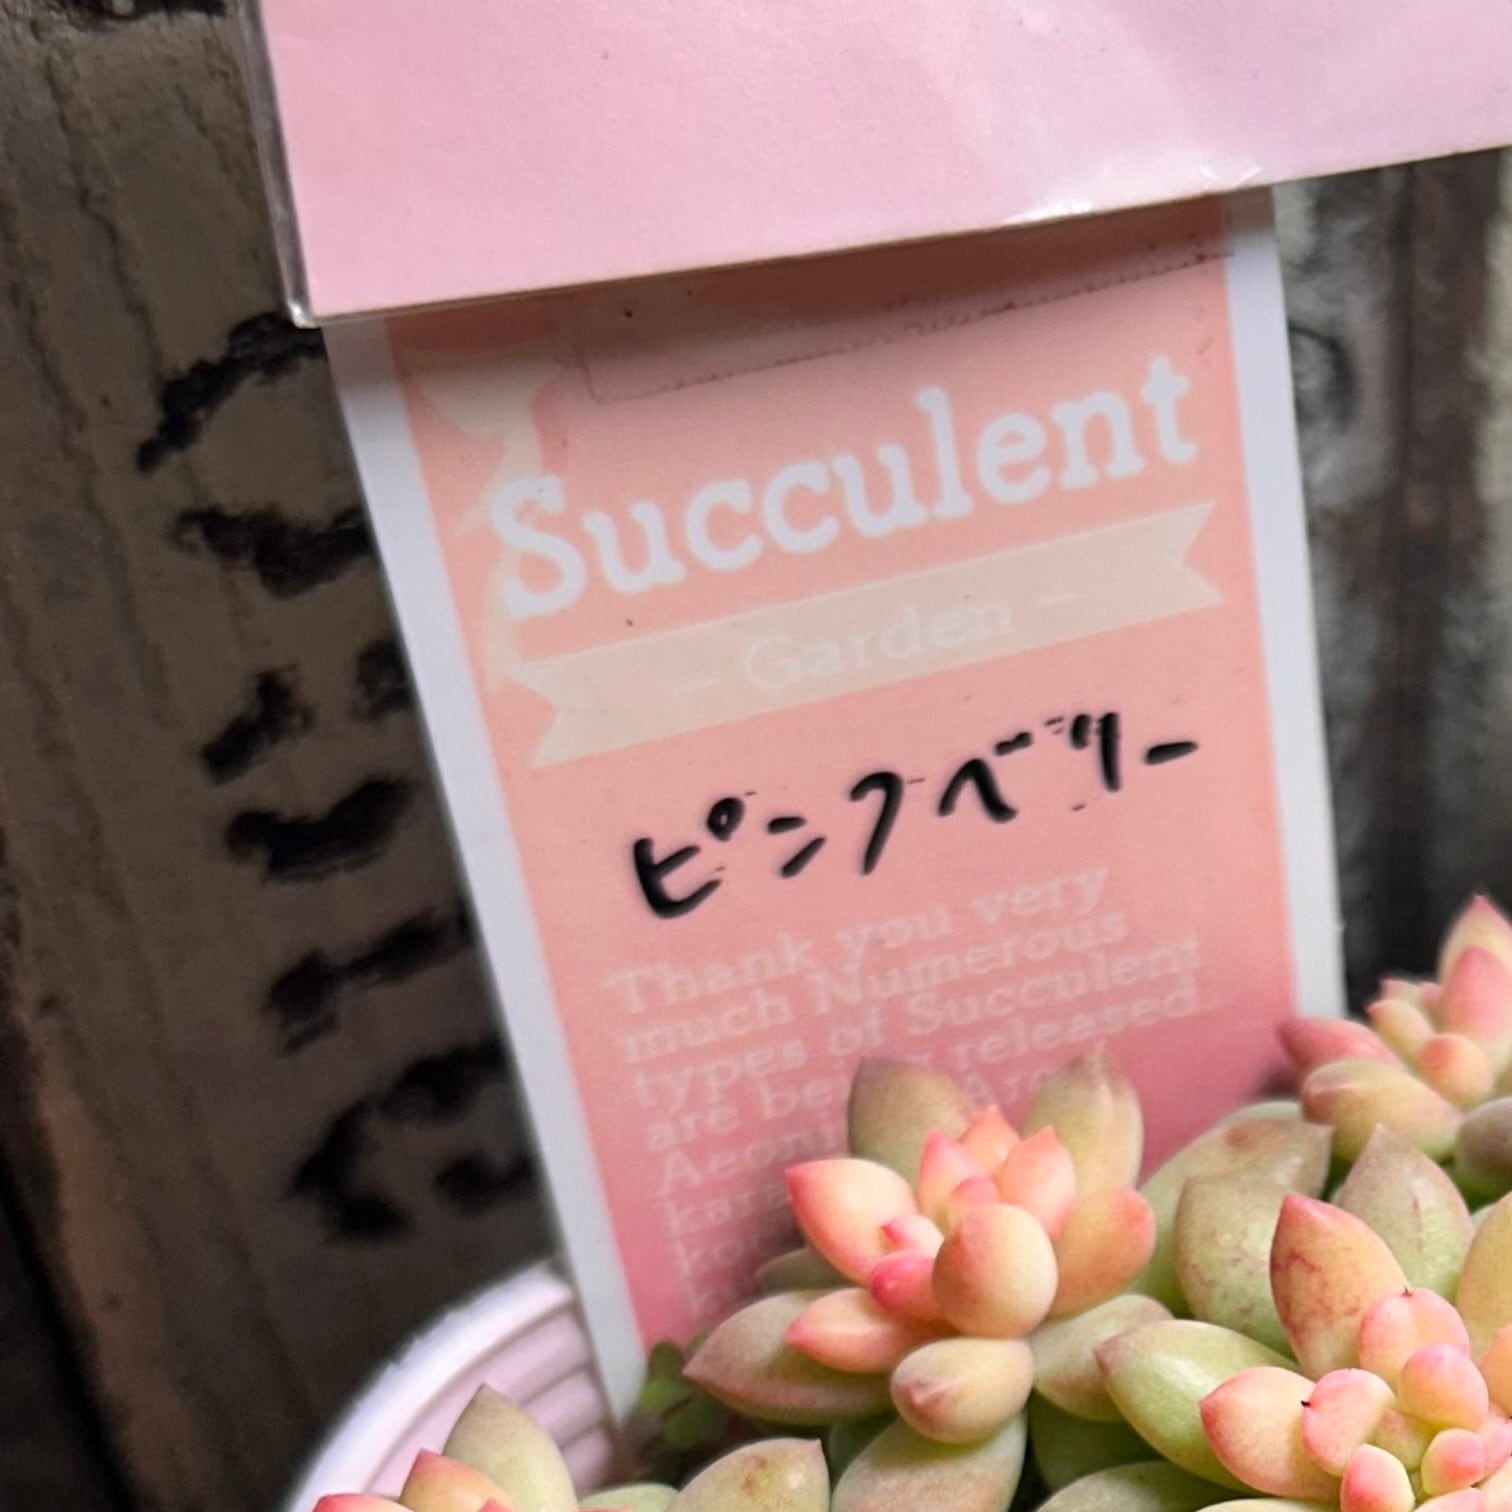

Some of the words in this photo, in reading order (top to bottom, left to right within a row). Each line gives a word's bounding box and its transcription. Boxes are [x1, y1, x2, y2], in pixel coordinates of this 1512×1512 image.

[491, 355, 1199, 623] Succulent
[740, 598, 1016, 692] Garden
[606, 932, 816, 1015] Thank
[835, 903, 955, 977] you
[969, 865, 1112, 925] very
[615, 988, 794, 1065] much
[807, 911, 1128, 1016] Numerous
[630, 1036, 808, 1116] types
[827, 1003, 887, 1058] of
[904, 932, 1203, 1037] Succulent
[644, 1101, 741, 1153] are
[949, 976, 1203, 1070] released
